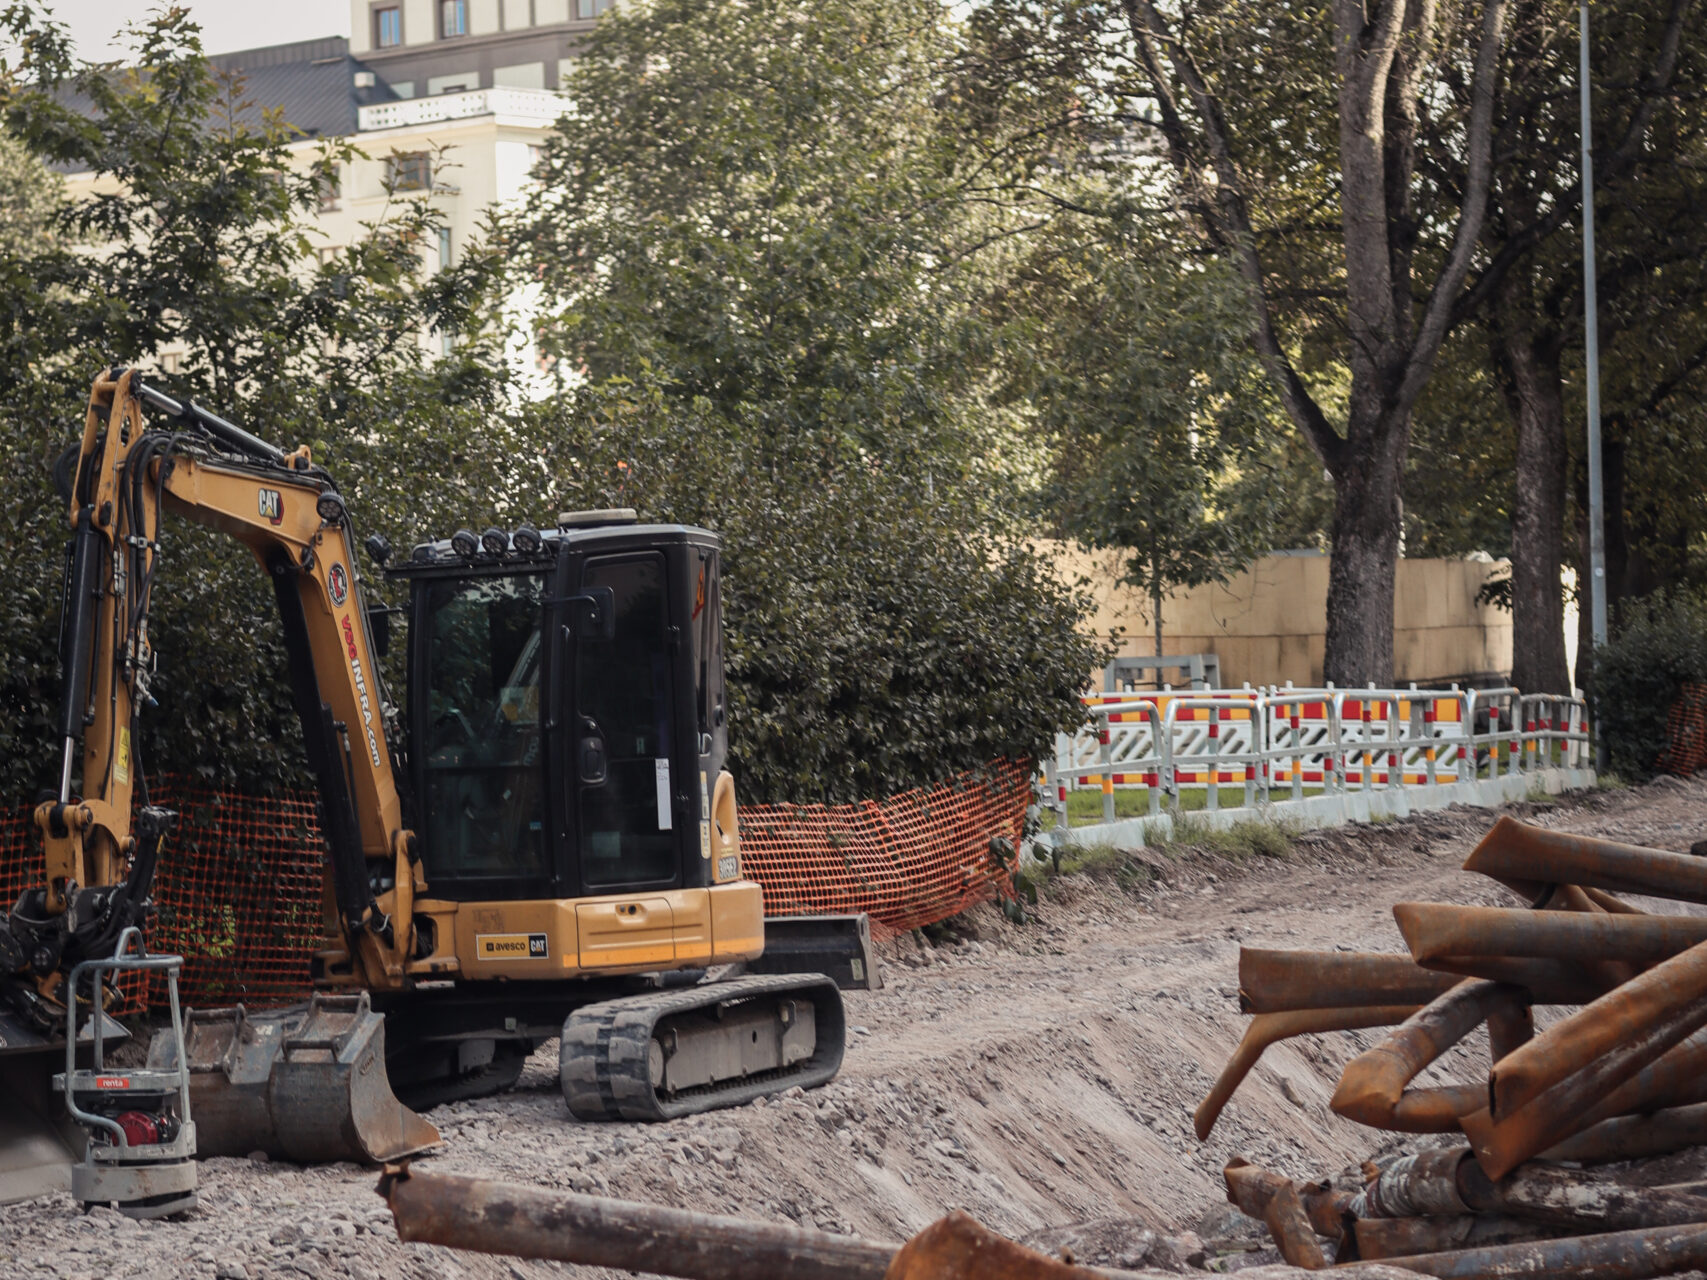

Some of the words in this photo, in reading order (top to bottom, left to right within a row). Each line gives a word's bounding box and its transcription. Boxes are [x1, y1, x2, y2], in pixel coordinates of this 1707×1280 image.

[259, 488, 279, 518] CAT
[496, 942, 525, 951] avesco
[530, 940, 545, 952] CAT
[103, 1079, 123, 1087] renta
